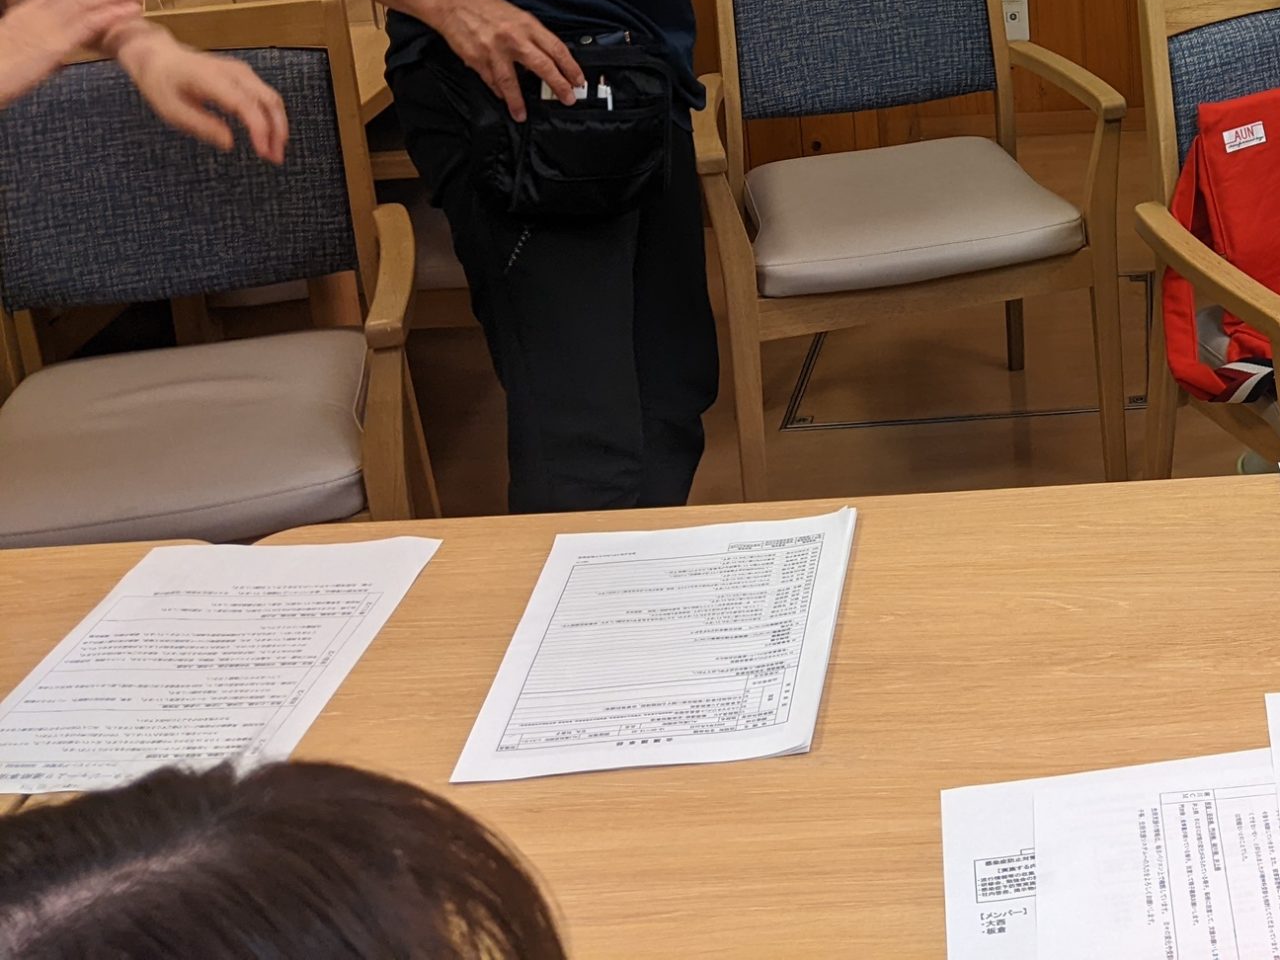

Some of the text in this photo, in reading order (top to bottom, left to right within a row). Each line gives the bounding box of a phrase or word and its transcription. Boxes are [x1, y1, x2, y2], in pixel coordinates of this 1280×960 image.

[1234, 126, 1255, 140] AUN
[981, 907, 1027, 920] 【メンバー】
